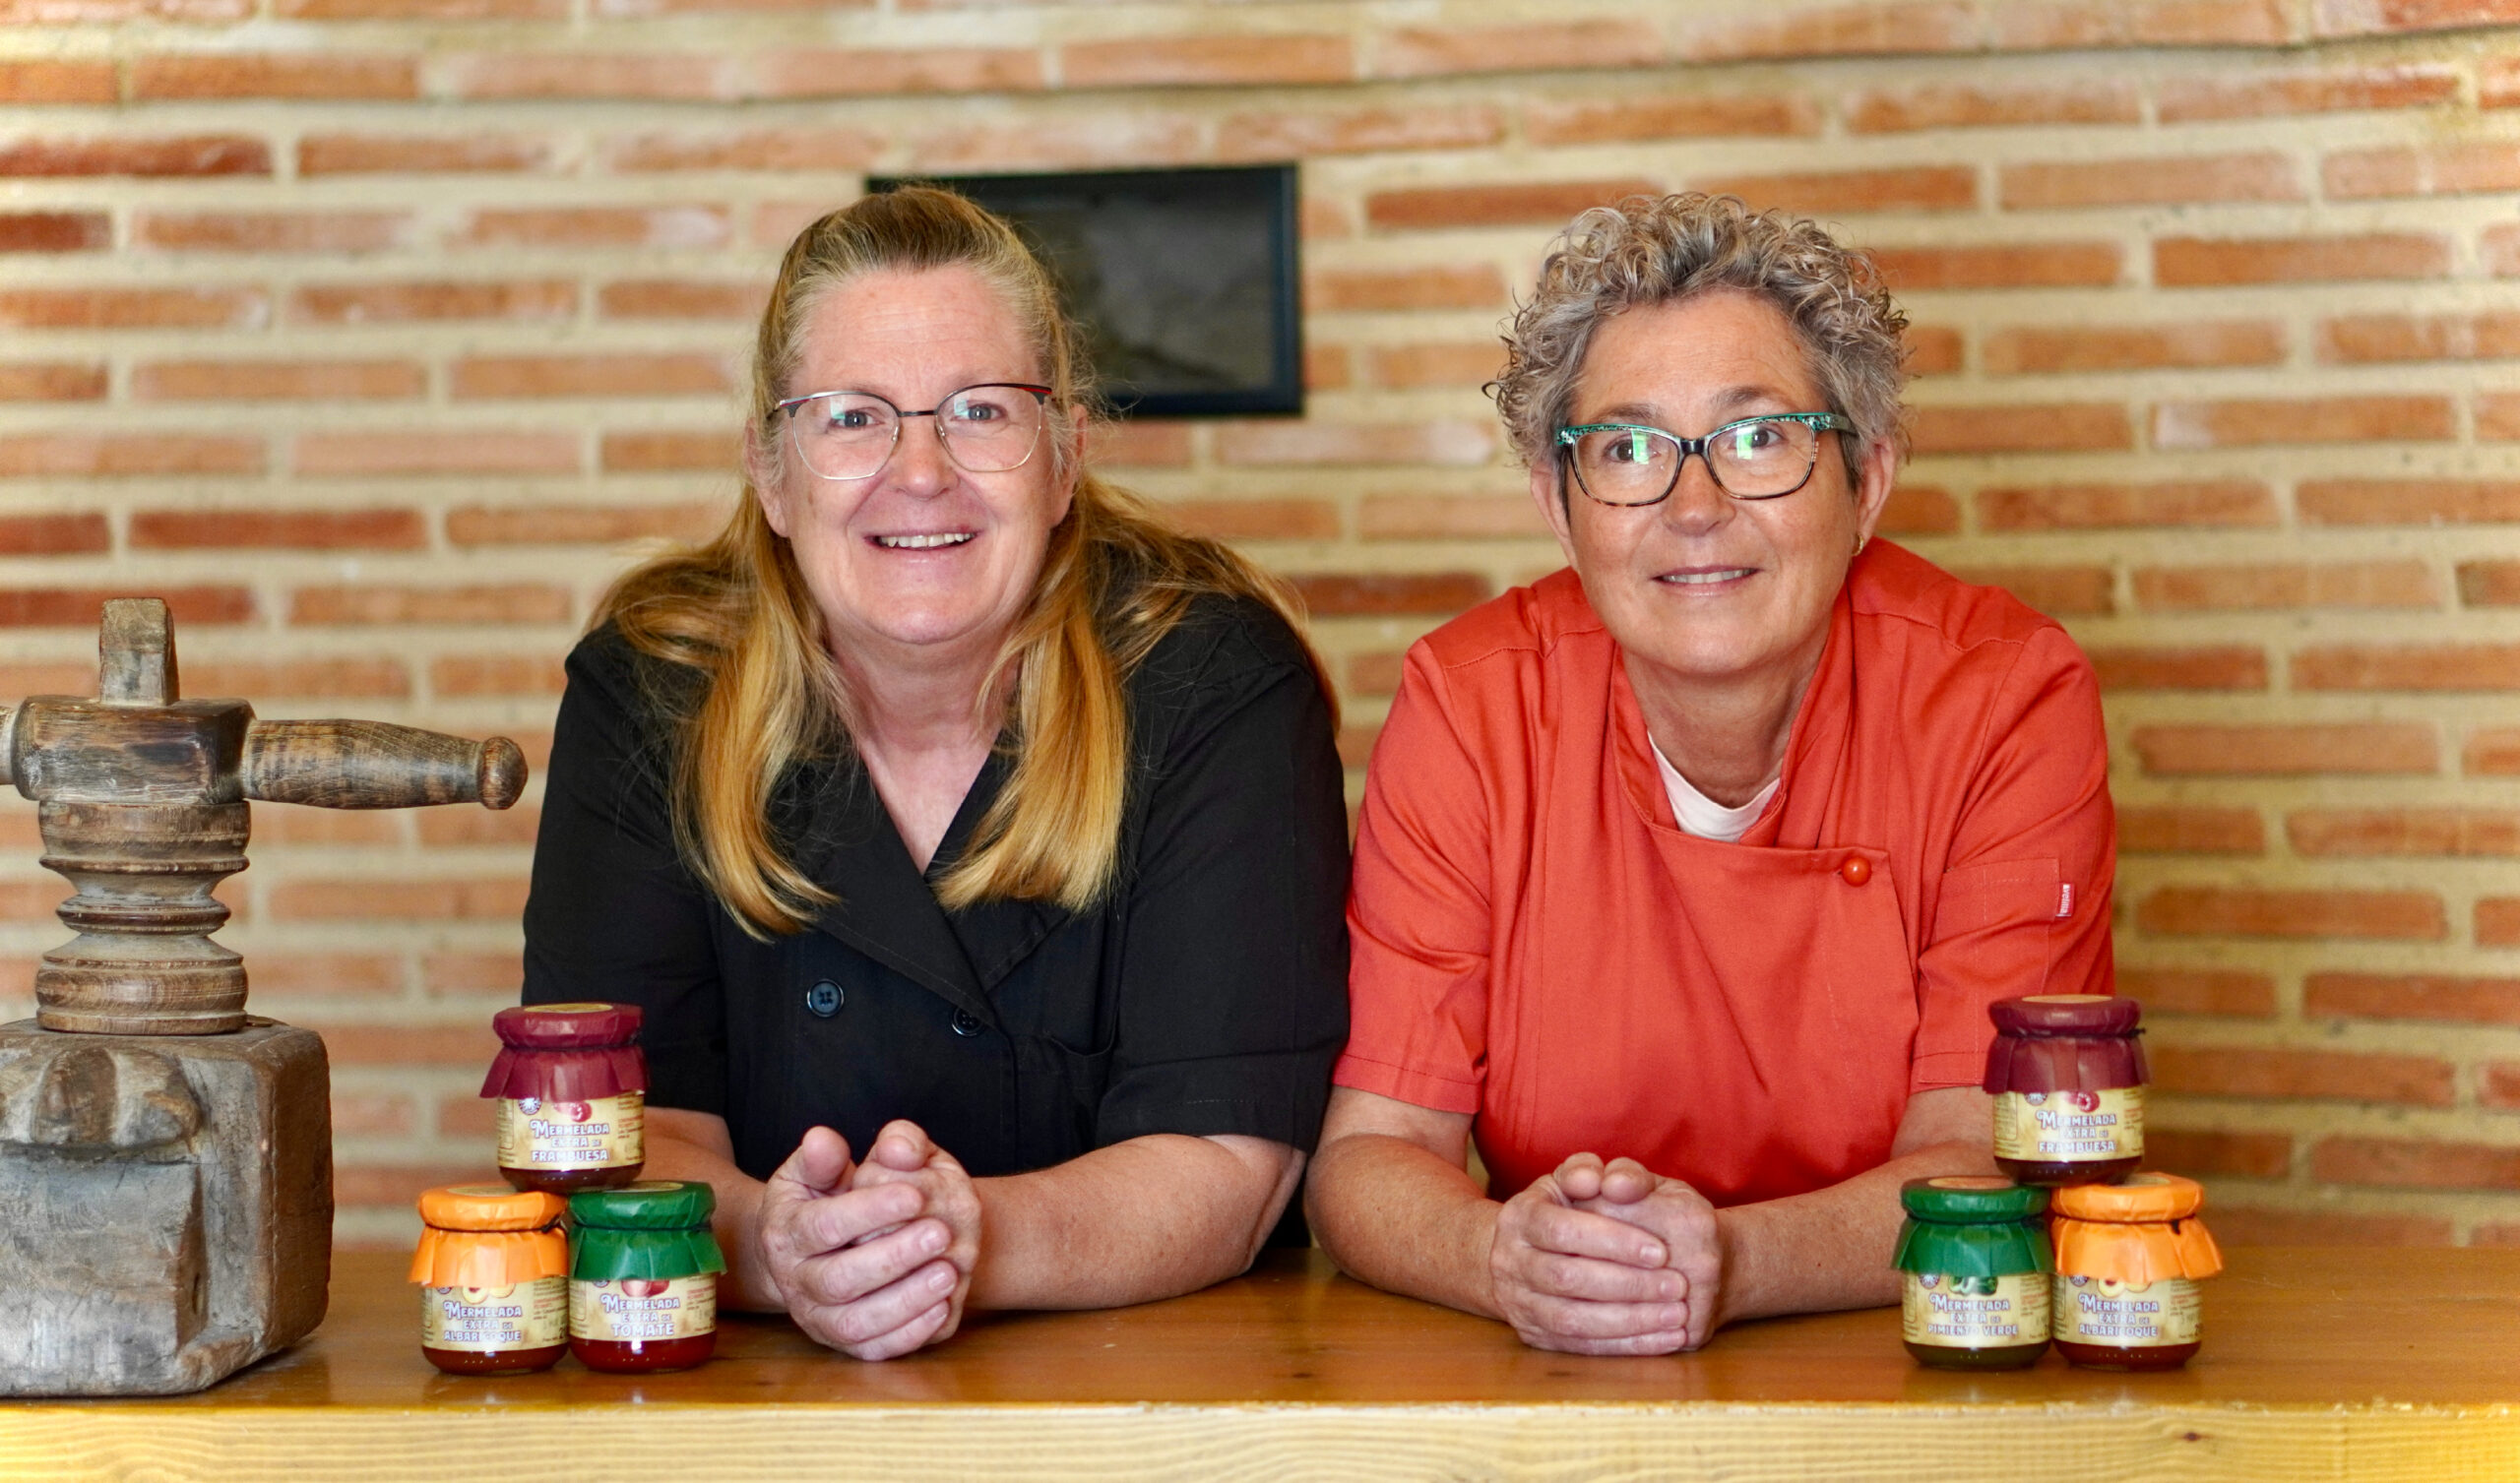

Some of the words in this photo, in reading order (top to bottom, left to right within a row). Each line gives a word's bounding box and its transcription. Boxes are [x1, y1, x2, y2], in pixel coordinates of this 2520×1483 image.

[2036, 1110, 2116, 1130] MERMELADA
[530, 1119, 609, 1139] MERMELADA
[2058, 1128, 2097, 1139] EXTRA
[551, 1137, 589, 1147] EXTRA
[2039, 1142, 2115, 1153] FRAMBUESA
[531, 1149, 609, 1162] FRAMBUESA
[600, 1292, 680, 1313] MERMELADA
[1929, 1292, 2010, 1313] MERMELADA
[2078, 1292, 2159, 1313] MERMELADA
[443, 1300, 523, 1320] MERMELADA
[621, 1312, 659, 1323] EXTRA
[1950, 1313, 1987, 1324] EXTRA
[2099, 1313, 2135, 1325] EXTRA
[463, 1320, 499, 1329] EXTRA
[611, 1323, 674, 1336] TOMATE
[1927, 1324, 1979, 1335] PIMIENTO
[1983, 1325, 2018, 1336] VERDE
[444, 1330, 521, 1342] ALBARICOQUE
[2079, 1324, 2158, 1338] ALBARICOQUE
